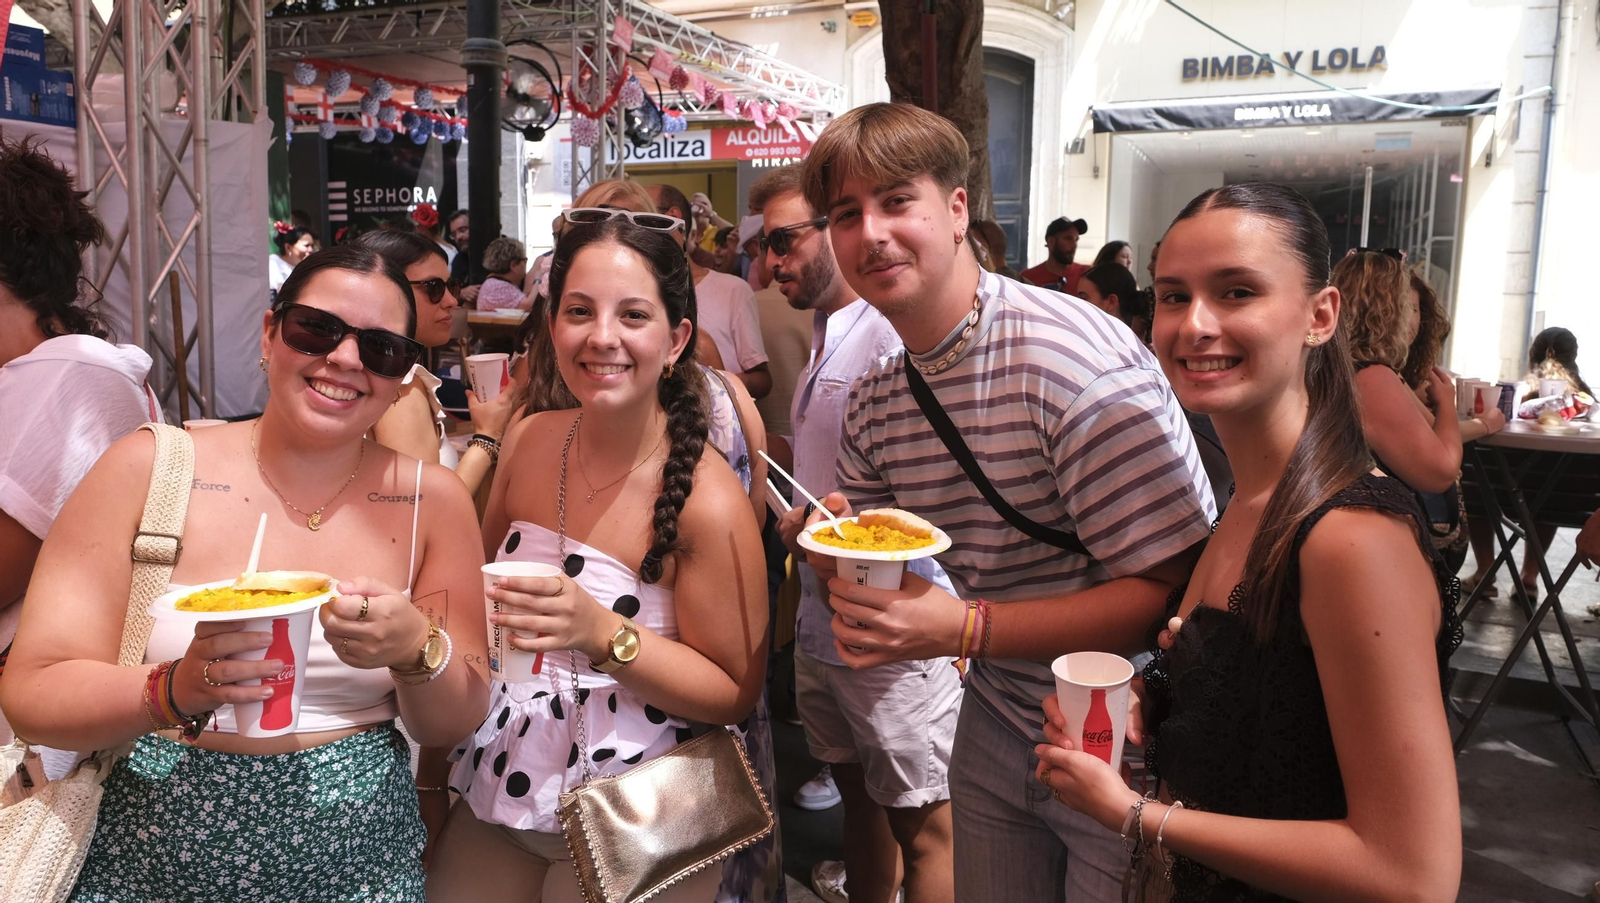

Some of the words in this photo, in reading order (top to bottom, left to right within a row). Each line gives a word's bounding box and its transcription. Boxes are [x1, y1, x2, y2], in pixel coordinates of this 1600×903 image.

[4, 47, 40, 61] Mayones
[1182, 54, 1276, 80] BIMBA
[1284, 51, 1304, 72] Y
[1311, 46, 1388, 72] LOLA
[4, 76, 12, 111] Mayonesa
[1234, 106, 1280, 121] BIMBA
[1280, 106, 1292, 118] Y
[1294, 104, 1332, 118] LOLA
[726, 128, 800, 145] ALQUILA
[610, 132, 706, 160] localiza
[353, 186, 437, 204] SEPHORA
[191, 478, 231, 492] Force
[367, 492, 423, 505] Courage
